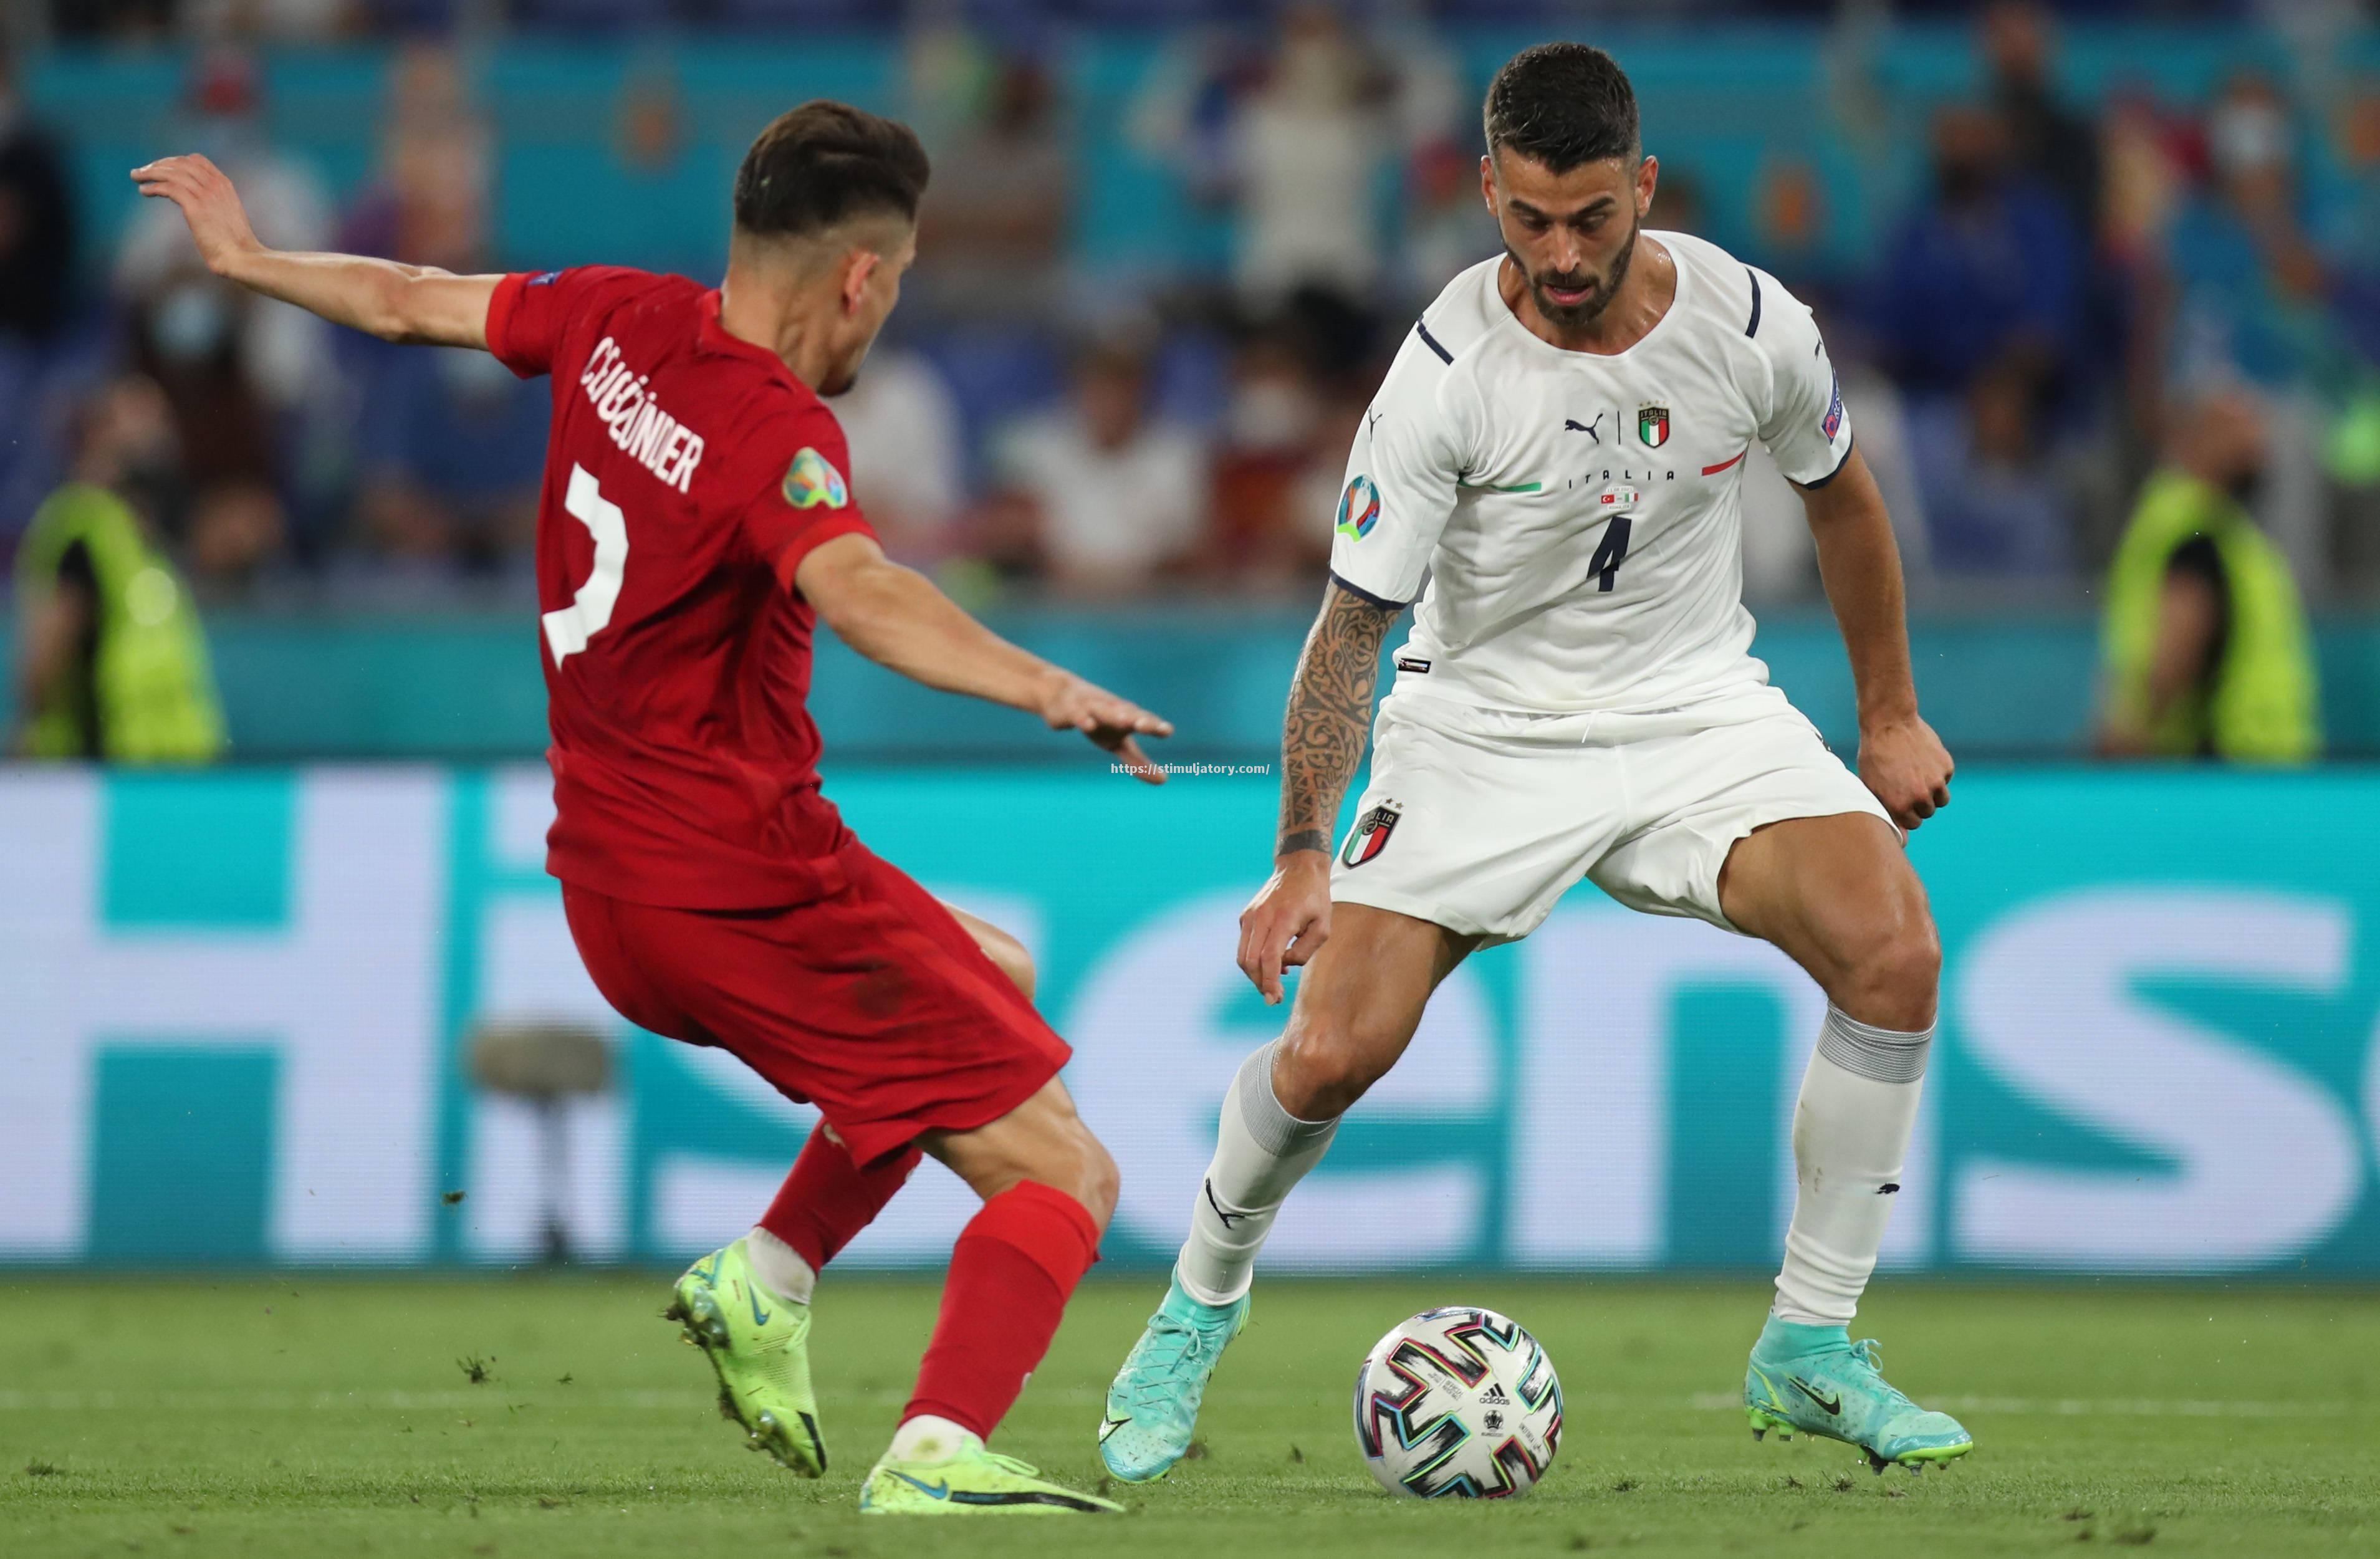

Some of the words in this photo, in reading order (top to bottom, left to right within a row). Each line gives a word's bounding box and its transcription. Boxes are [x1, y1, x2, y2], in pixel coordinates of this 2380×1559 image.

[1568, 470, 1674, 489] ITALIA
[1586, 516, 1632, 592] 4
[0, 764, 2380, 1267] Hiens
[1479, 1396, 1510, 1406] adidas
